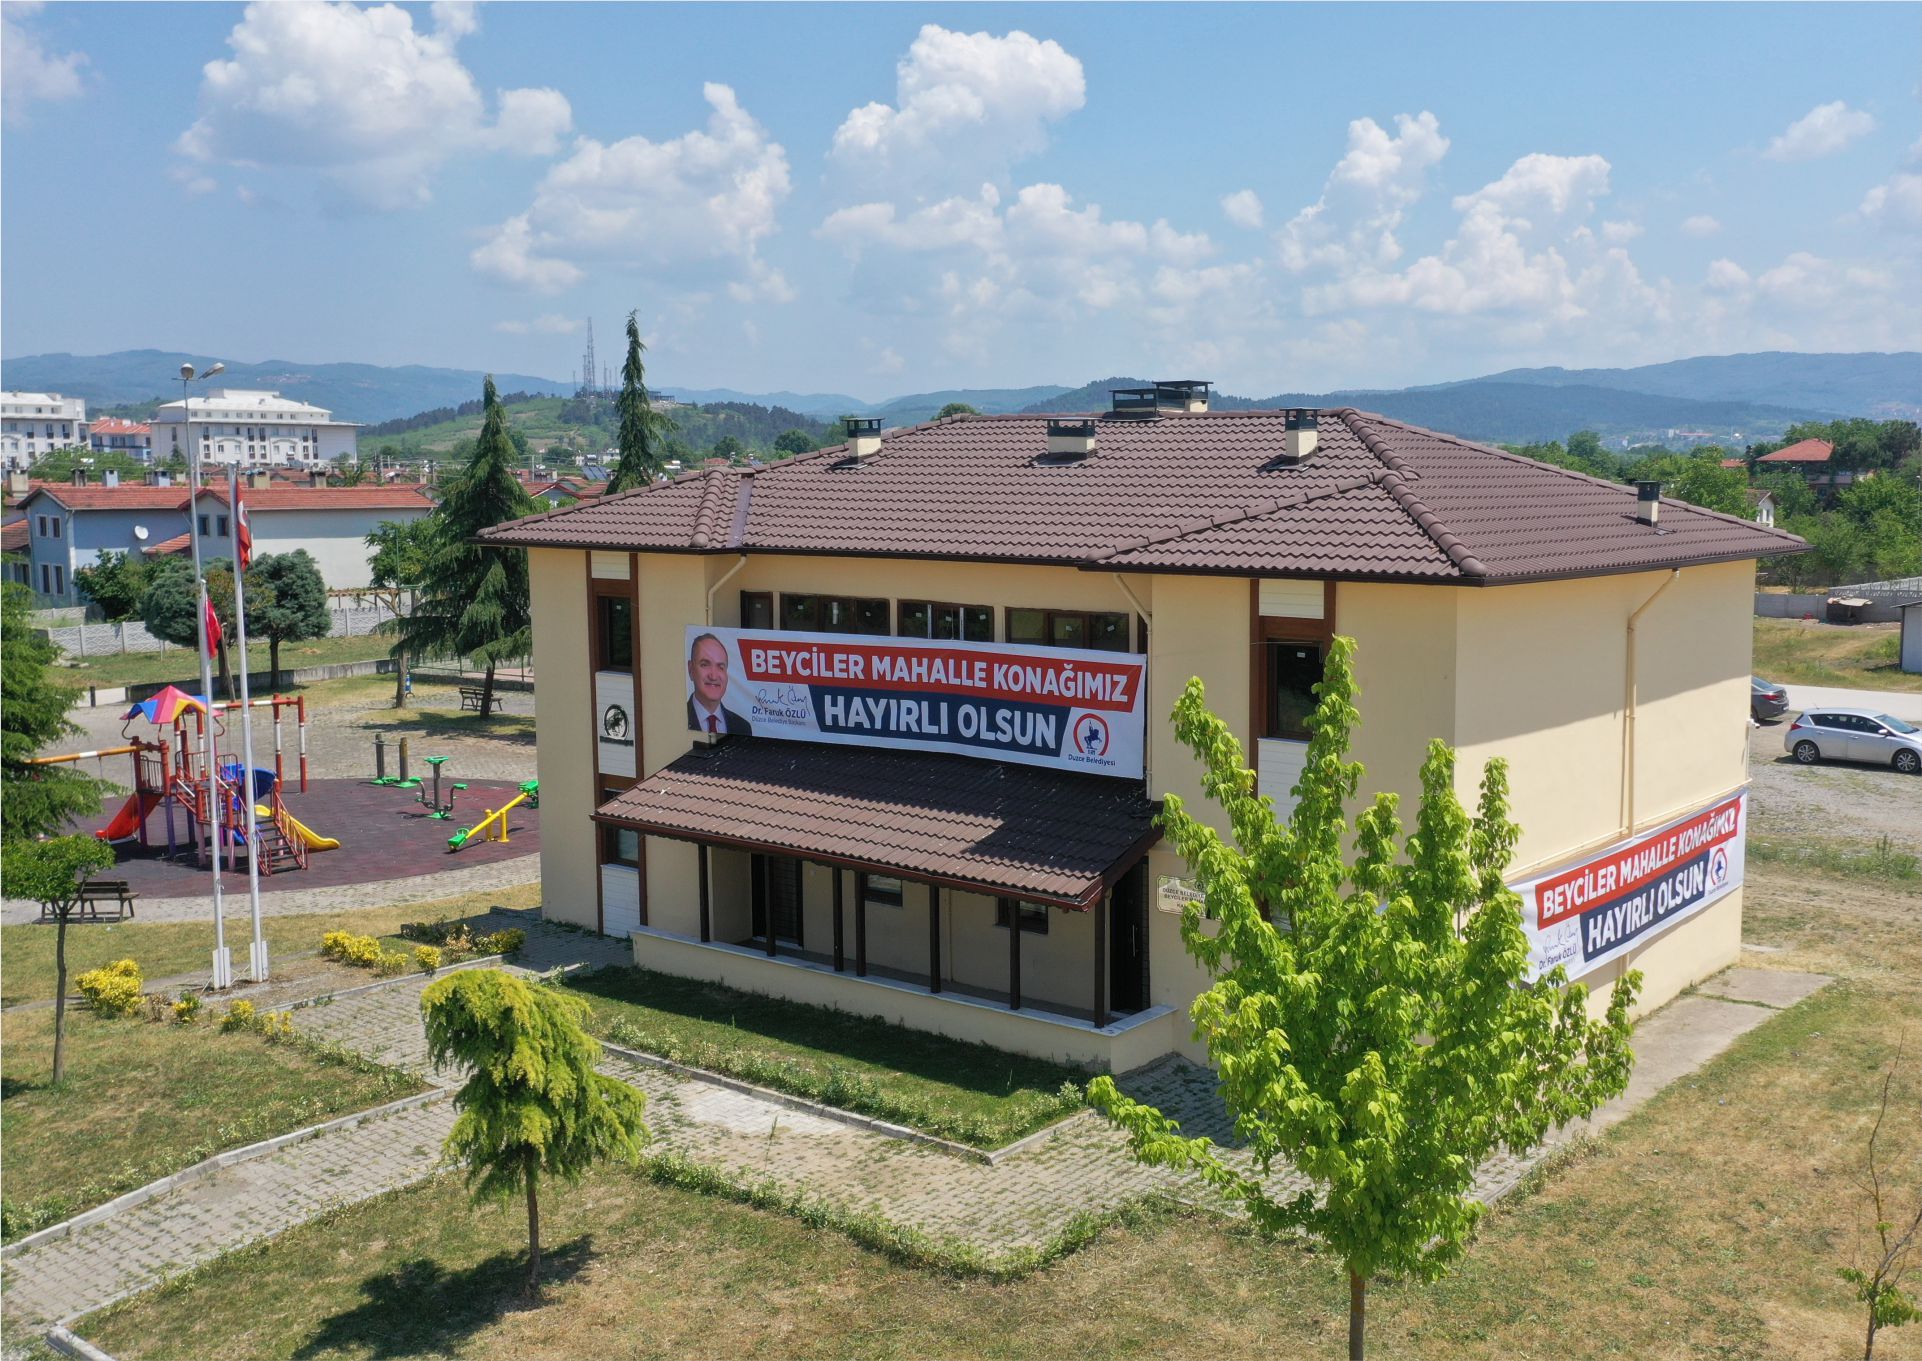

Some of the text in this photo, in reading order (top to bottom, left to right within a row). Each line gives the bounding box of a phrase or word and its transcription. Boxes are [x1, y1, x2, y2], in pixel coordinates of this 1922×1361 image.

[751, 646, 1129, 703] BEYCİLER MAHALLE KONAĞIMIZ
[752, 705, 806, 719] Dr. Faruk ÖZLÜ
[824, 694, 949, 735] HAYIRLI
[957, 703, 1057, 749] OLSUN
[1086, 756, 1116, 767] Belediyesi
[1542, 807, 1736, 920] BEYCİLER MAHALLE KONAĞIMIZ
[1587, 889, 1655, 953] HAYIRLI
[1657, 861, 1705, 915] OLSUN
